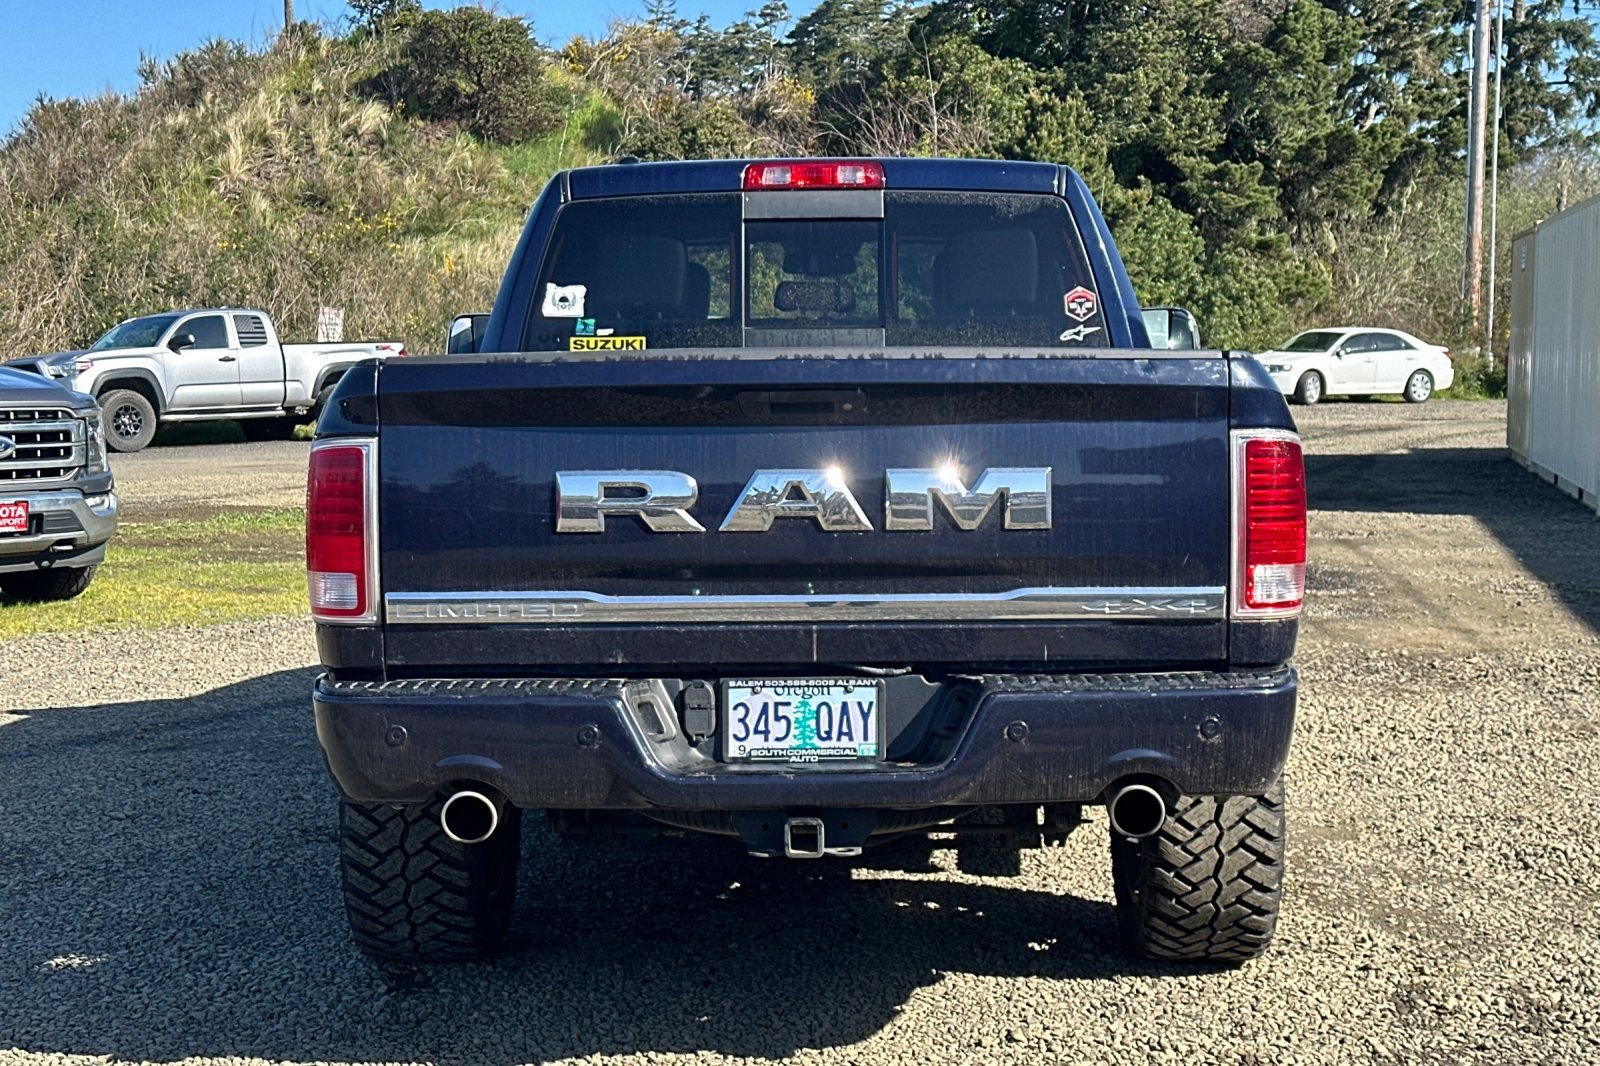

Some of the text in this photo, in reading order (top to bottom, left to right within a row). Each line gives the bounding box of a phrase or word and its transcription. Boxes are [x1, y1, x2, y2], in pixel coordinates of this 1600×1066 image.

[572, 339, 644, 350] SUZUKI
[555, 467, 1052, 533] RAM
[396, 602, 586, 618] LIMITED
[774, 686, 831, 699] Oregon
[732, 701, 874, 742] 345 QAY
[738, 745, 746, 755] 9
